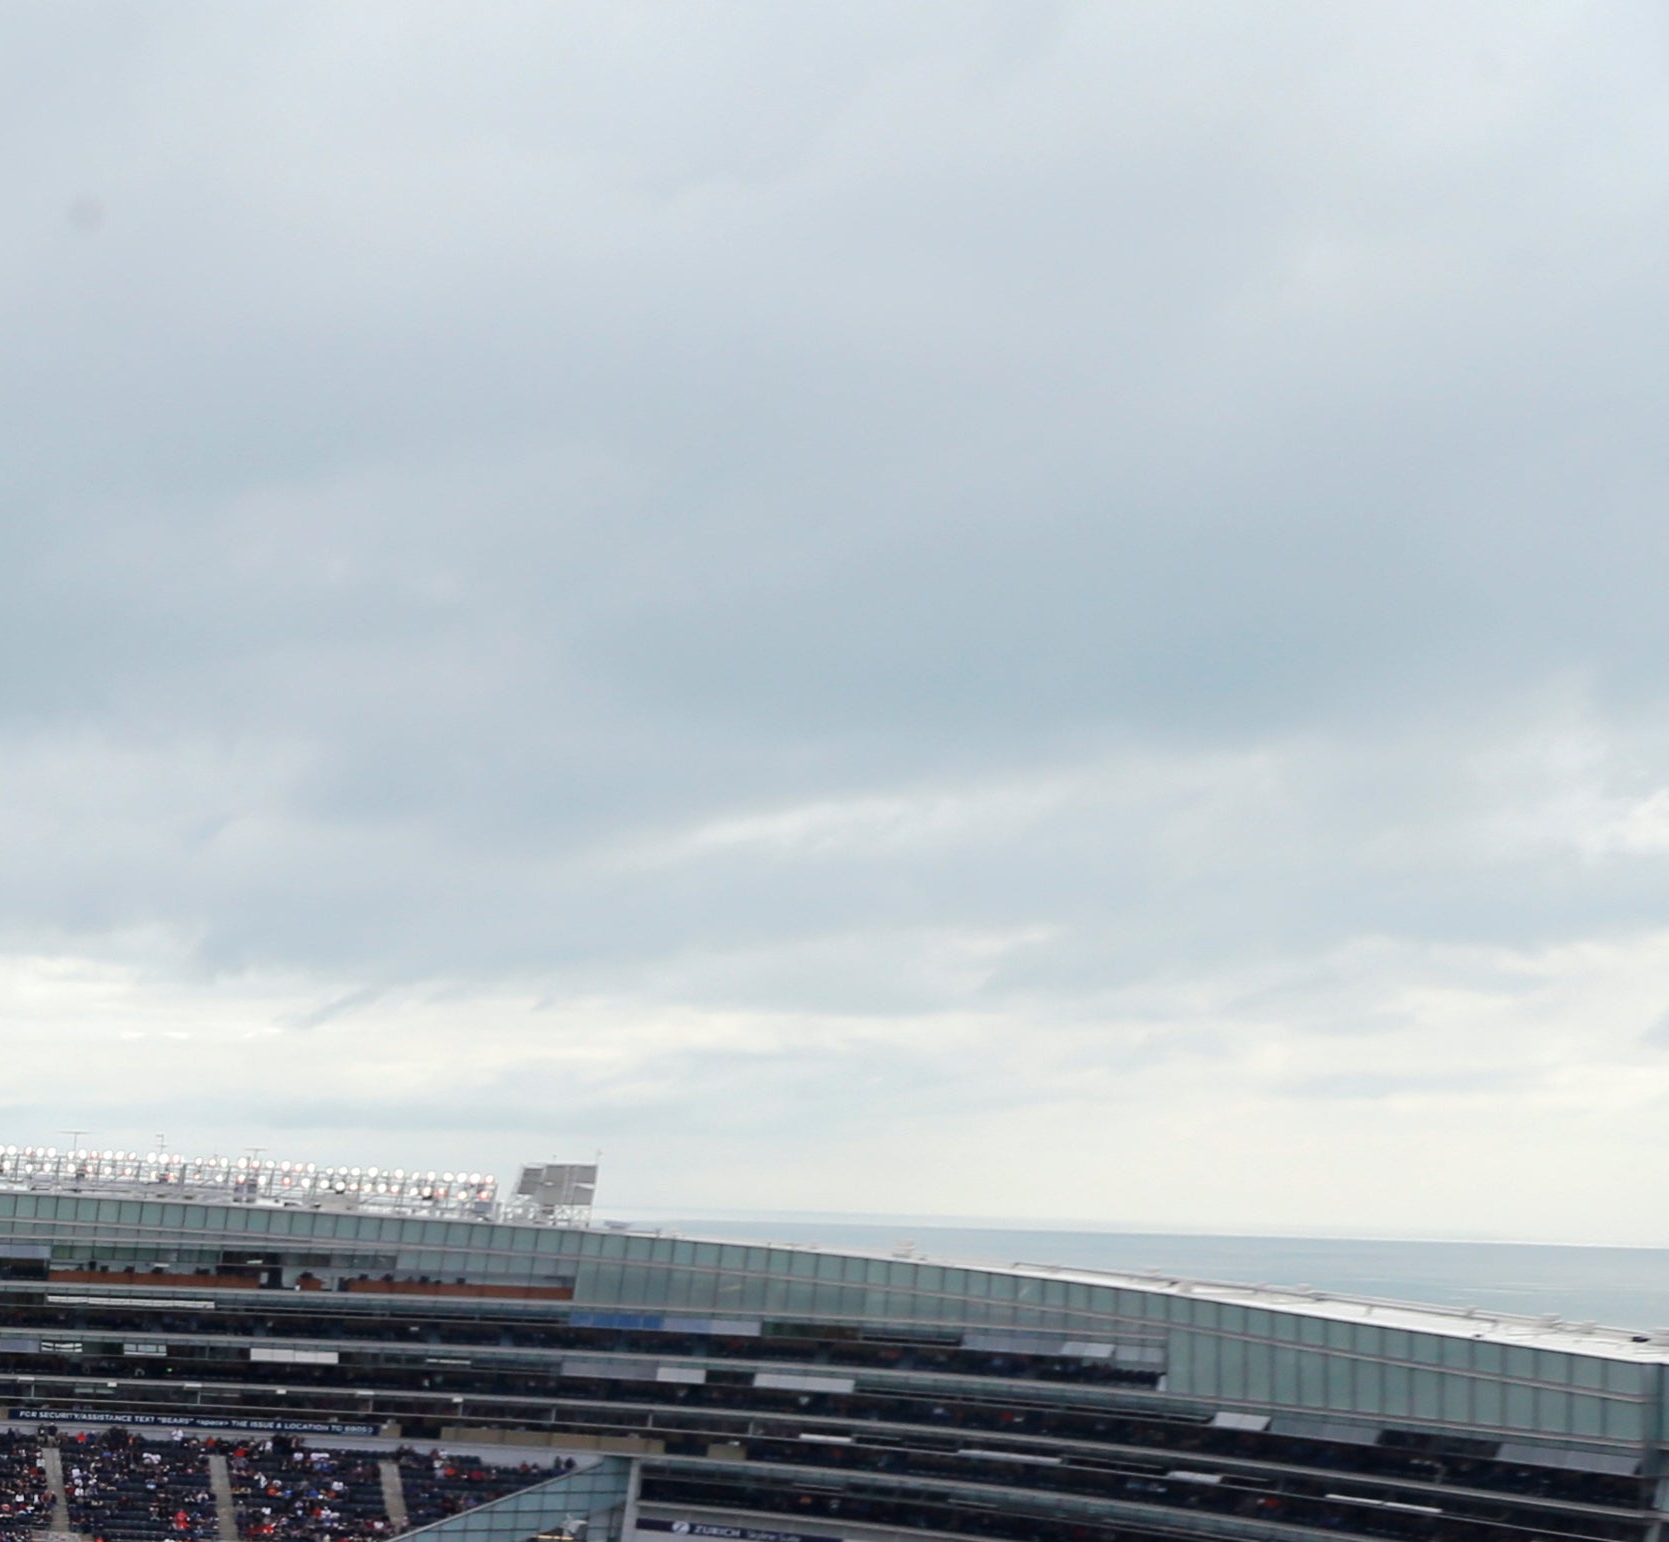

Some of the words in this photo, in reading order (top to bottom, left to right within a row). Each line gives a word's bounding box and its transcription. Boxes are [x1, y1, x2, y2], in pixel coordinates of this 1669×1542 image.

[134, 1415, 155, 1423] TEXT
[232, 1419, 248, 1428] THE
[692, 1525, 741, 1538] ZURICH
